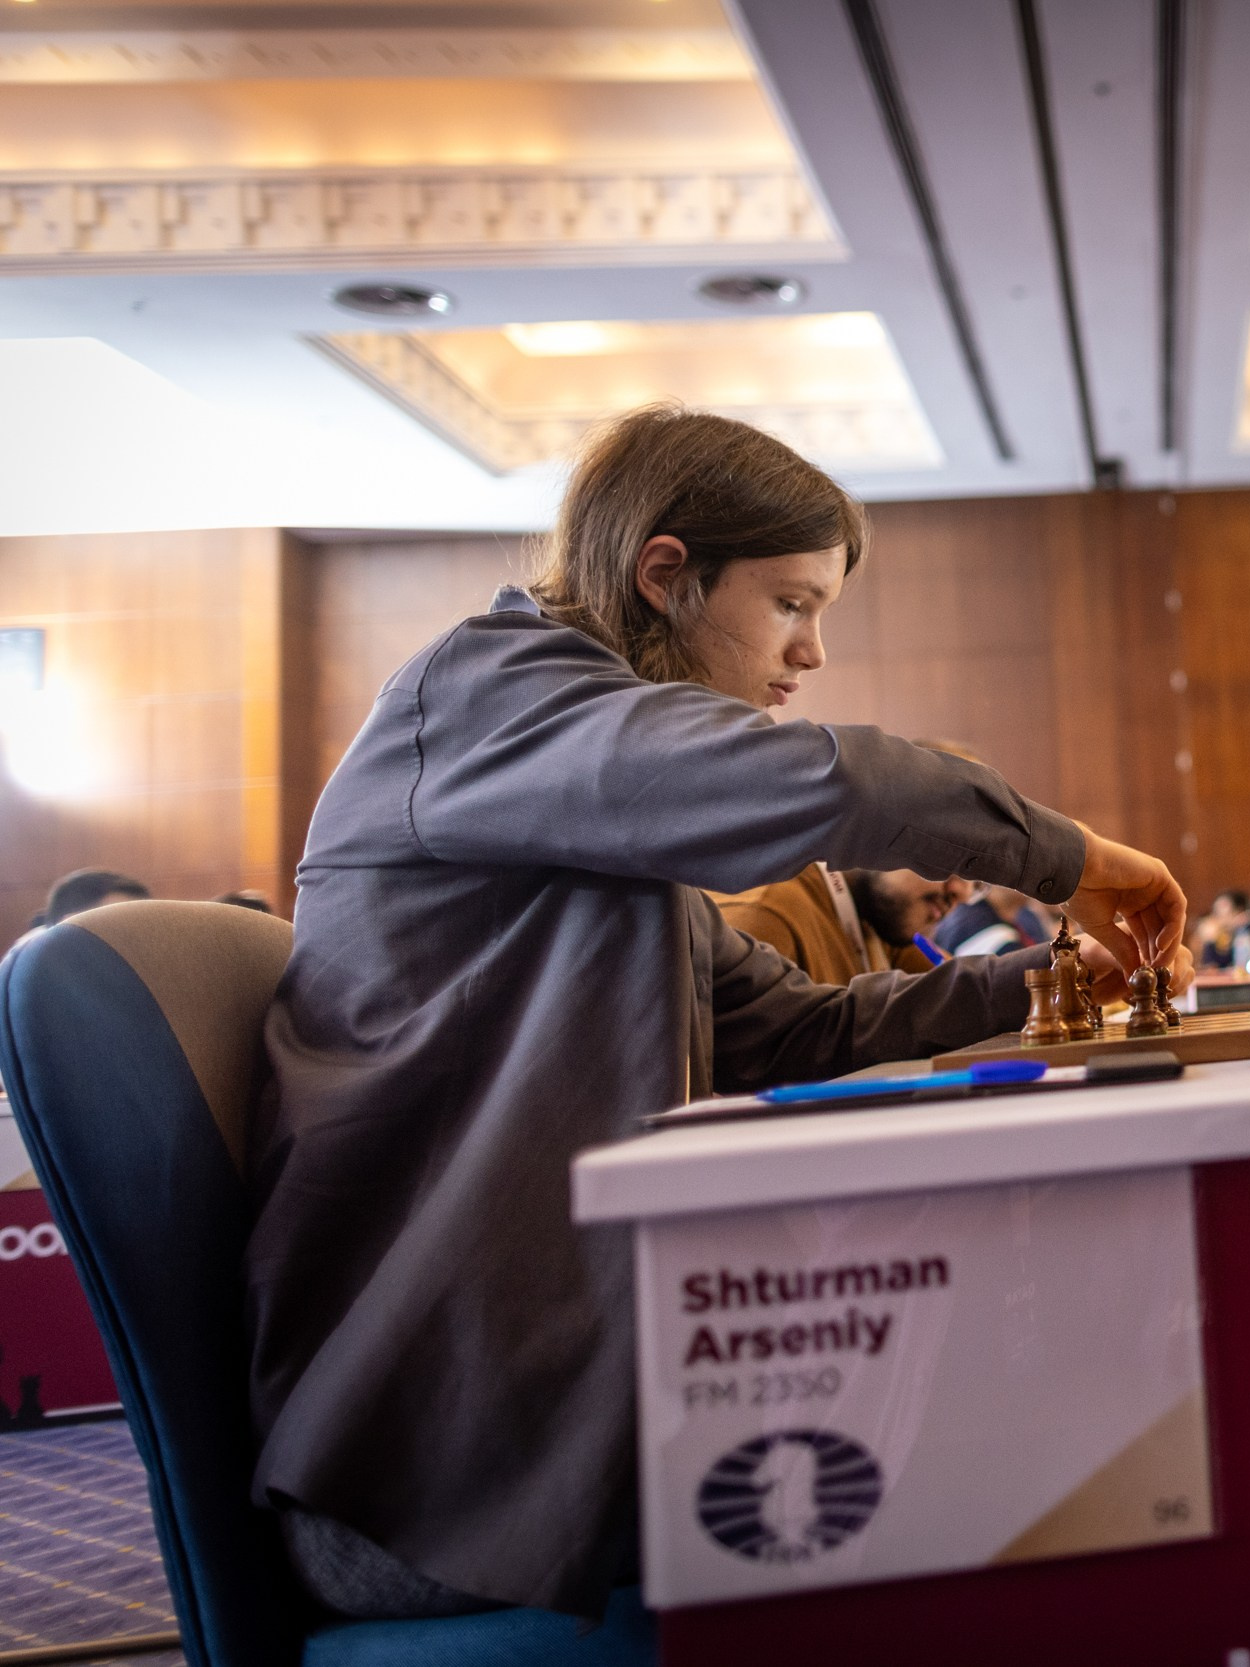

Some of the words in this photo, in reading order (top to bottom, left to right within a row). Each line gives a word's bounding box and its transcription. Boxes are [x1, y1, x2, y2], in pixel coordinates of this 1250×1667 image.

[682, 1255, 949, 1313] Shturman
[683, 1307, 892, 1368] Arseniy
[682, 1380, 739, 1410] FM
